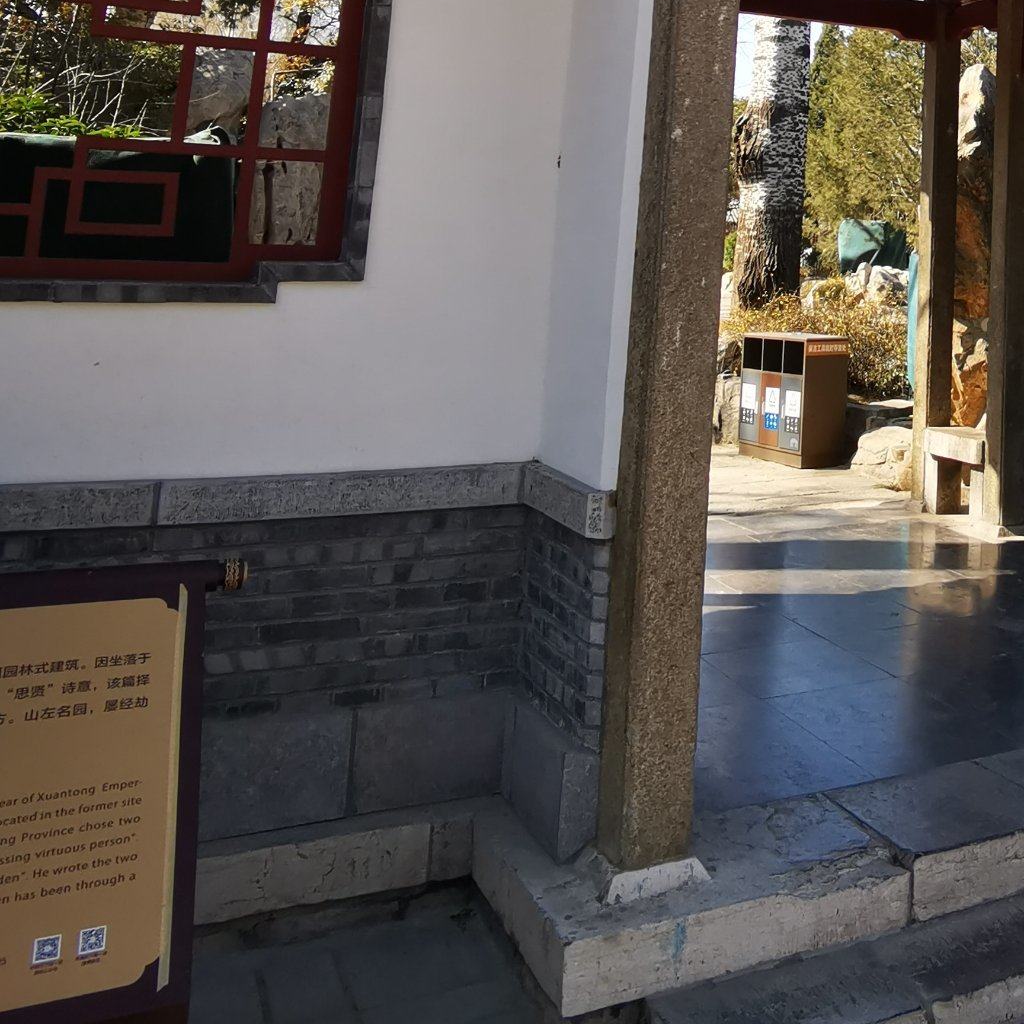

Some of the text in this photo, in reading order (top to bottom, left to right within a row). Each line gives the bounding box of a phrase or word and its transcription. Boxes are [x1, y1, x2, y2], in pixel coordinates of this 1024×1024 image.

[0, 653, 152, 678] 园林式建筑。因坐落于
[21, 792, 36, 804] of
[36, 786, 96, 802] Xuantong
[102, 780, 143, 792] Emper-
[0, 797, 142, 826] cated in the former site
[21, 827, 74, 842] Province
[79, 820, 114, 832] chose
[119, 815, 141, 826] two
[35, 843, 86, 858] virtuous
[32, 868, 49, 878] He
[53, 862, 88, 875] wrote
[92, 857, 112, 868] the
[115, 853, 138, 865] two
[14, 891, 36, 902] has
[40, 884, 71, 897] been
[76, 872, 125, 891] through
